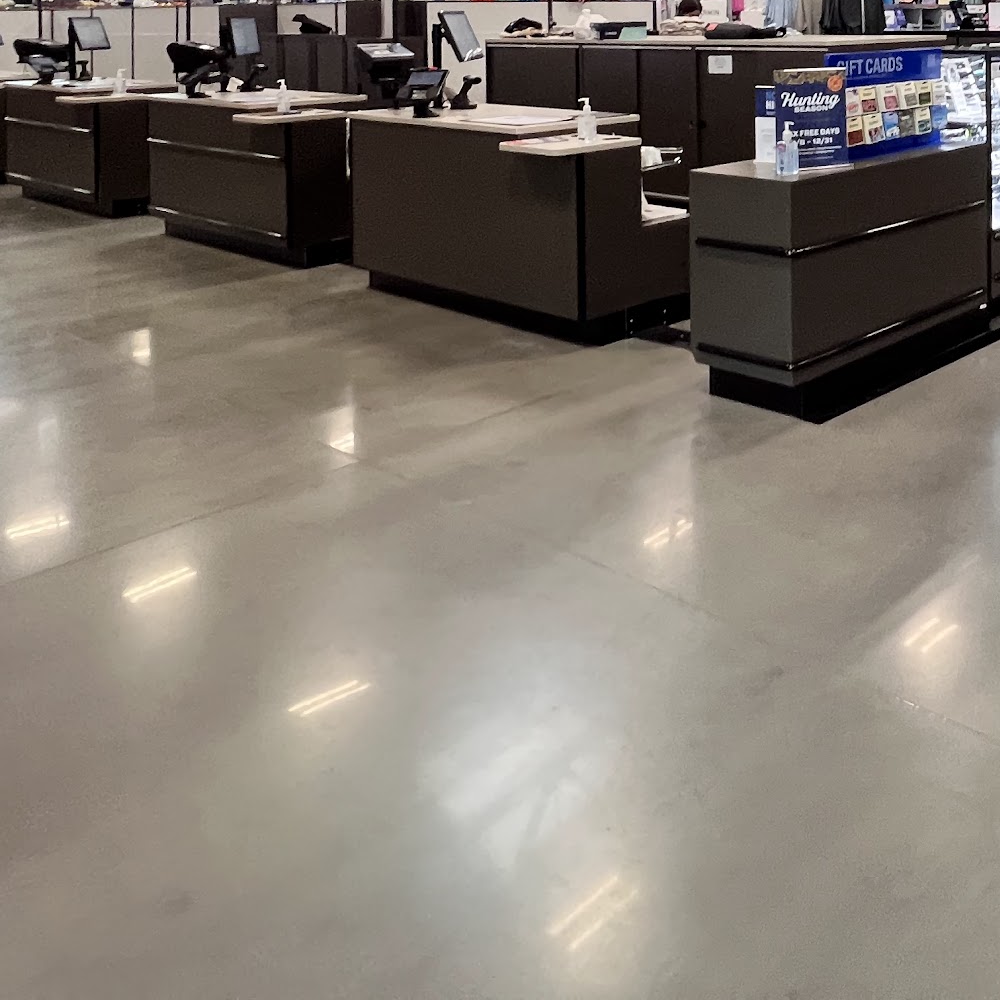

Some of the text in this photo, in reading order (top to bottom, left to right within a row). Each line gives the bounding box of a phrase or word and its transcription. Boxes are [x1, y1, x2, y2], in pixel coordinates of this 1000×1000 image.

[865, 56, 903, 74] CARDS
[780, 91, 841, 110] Hunting
[794, 105, 828, 113] SEASON
